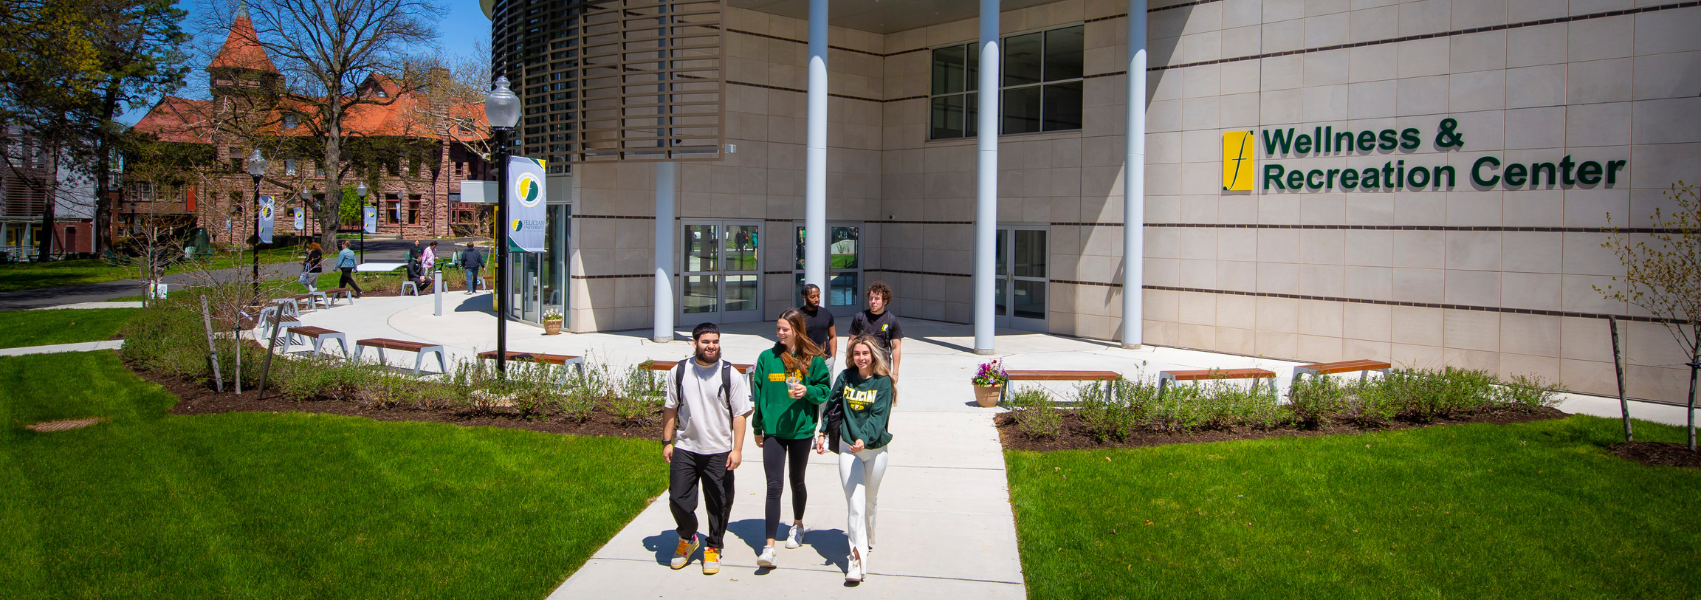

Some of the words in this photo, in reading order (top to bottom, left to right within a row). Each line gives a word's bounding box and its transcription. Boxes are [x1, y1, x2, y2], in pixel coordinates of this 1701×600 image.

[1262, 125, 1421, 155] Wellness
[1435, 117, 1465, 148] &
[1263, 159, 1456, 190] Recreation
[1471, 154, 1627, 187] Center
